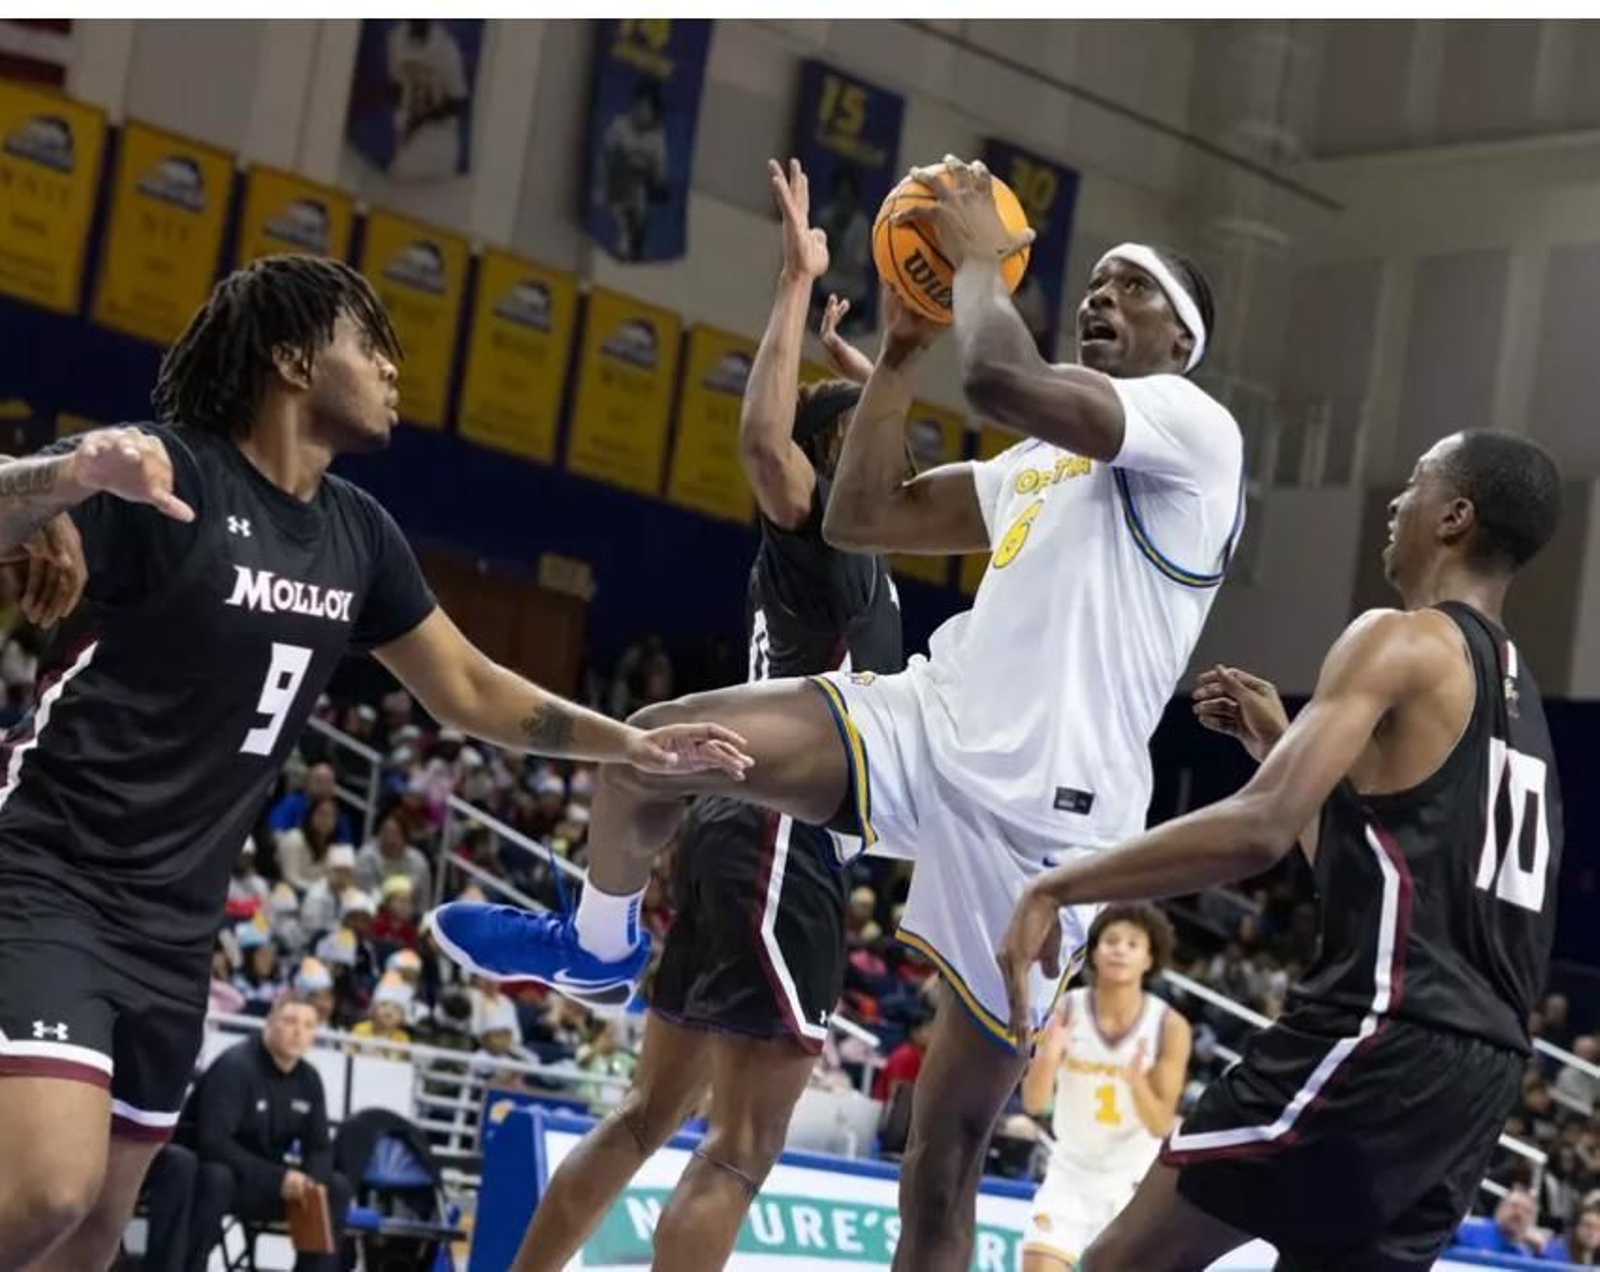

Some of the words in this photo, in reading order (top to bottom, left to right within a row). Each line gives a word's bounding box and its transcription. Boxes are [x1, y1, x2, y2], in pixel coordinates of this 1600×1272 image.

[992, 497, 1044, 570] 6
[238, 641, 315, 757] 9
[1474, 735, 1551, 914] 10
[1094, 1083, 1122, 1126] 1
[624, 1196, 902, 1254] NURE'S
